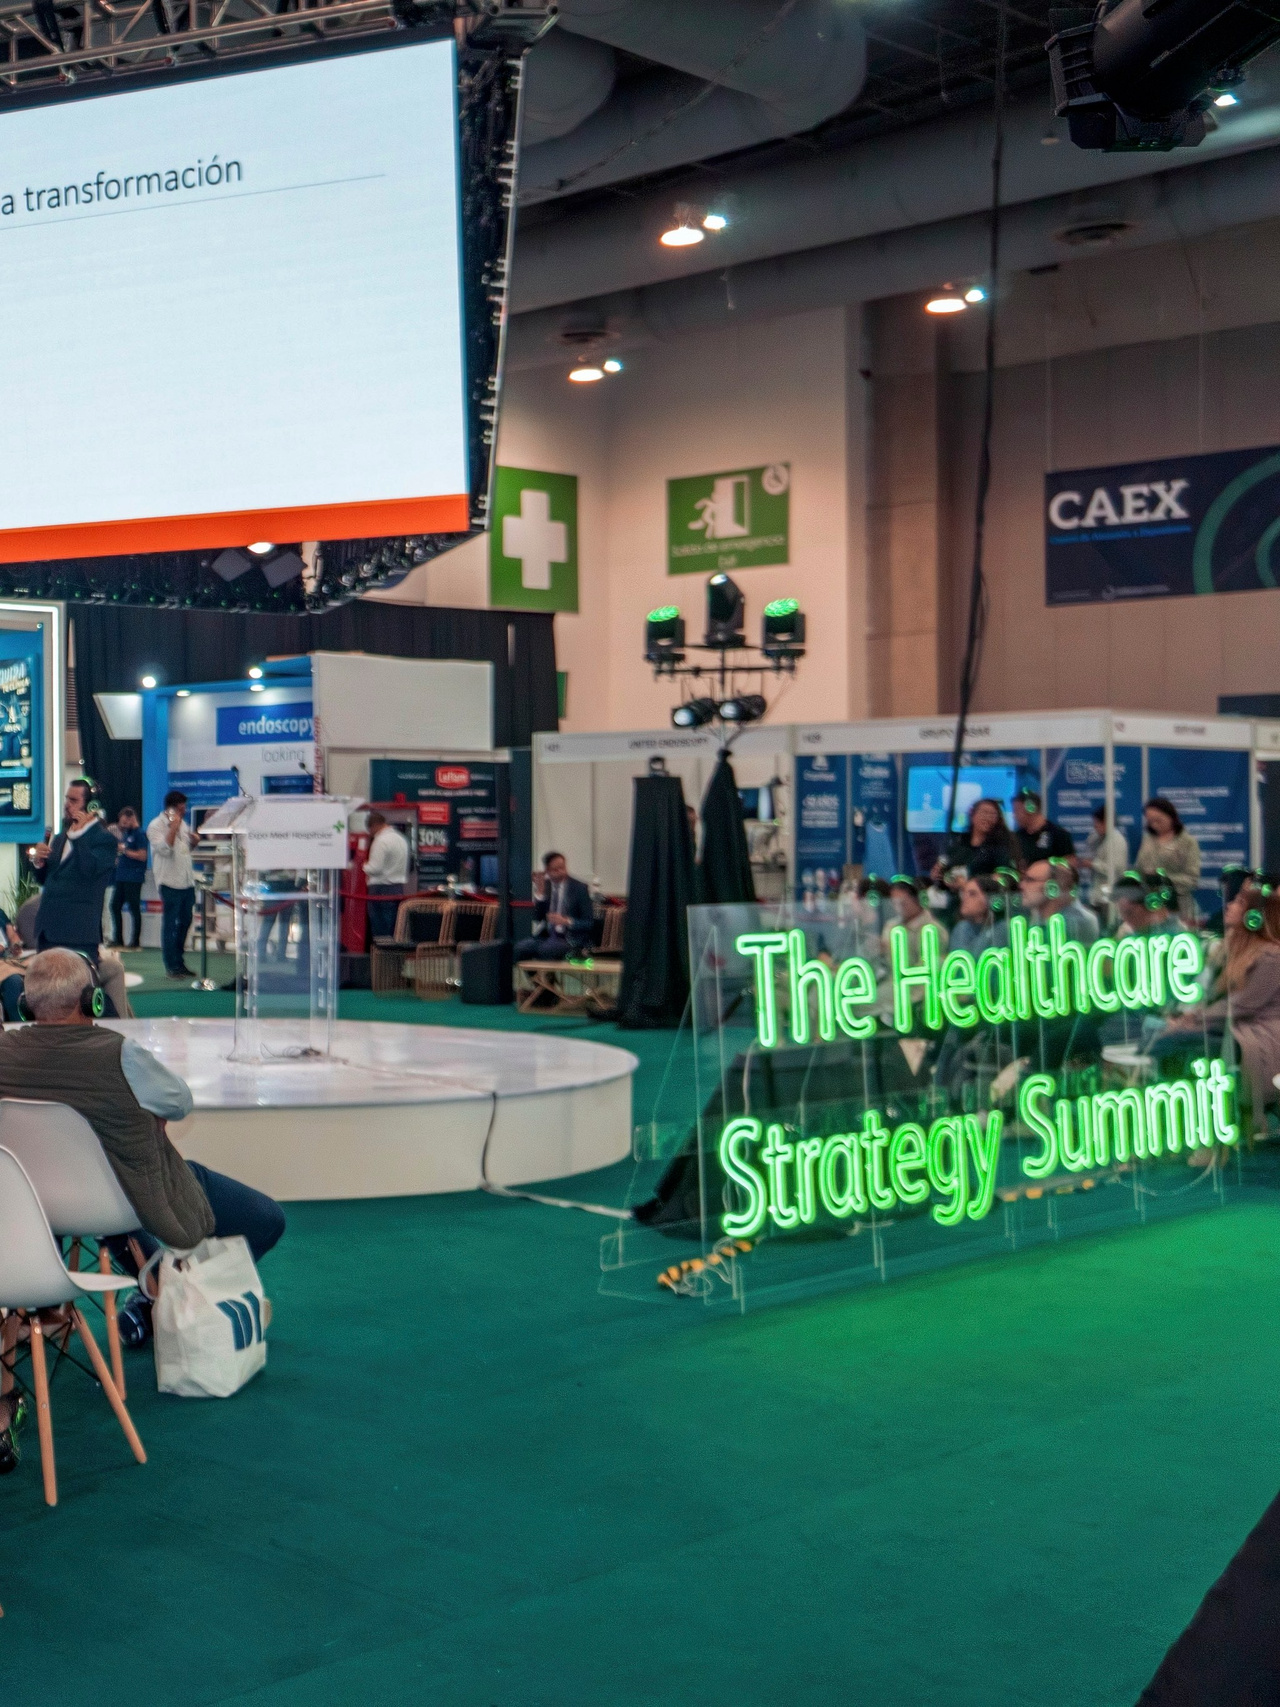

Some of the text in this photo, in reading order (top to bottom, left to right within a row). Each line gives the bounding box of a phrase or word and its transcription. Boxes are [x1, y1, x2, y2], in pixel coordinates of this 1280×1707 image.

[23, 155, 242, 212] transformación
[1048, 478, 1190, 530] CAEX
[261, 747, 305, 762] looking
[417, 829, 449, 847] 30%
[735, 913, 1203, 1048] The Healthcare
[719, 1057, 1239, 1239] Strategy Summit
